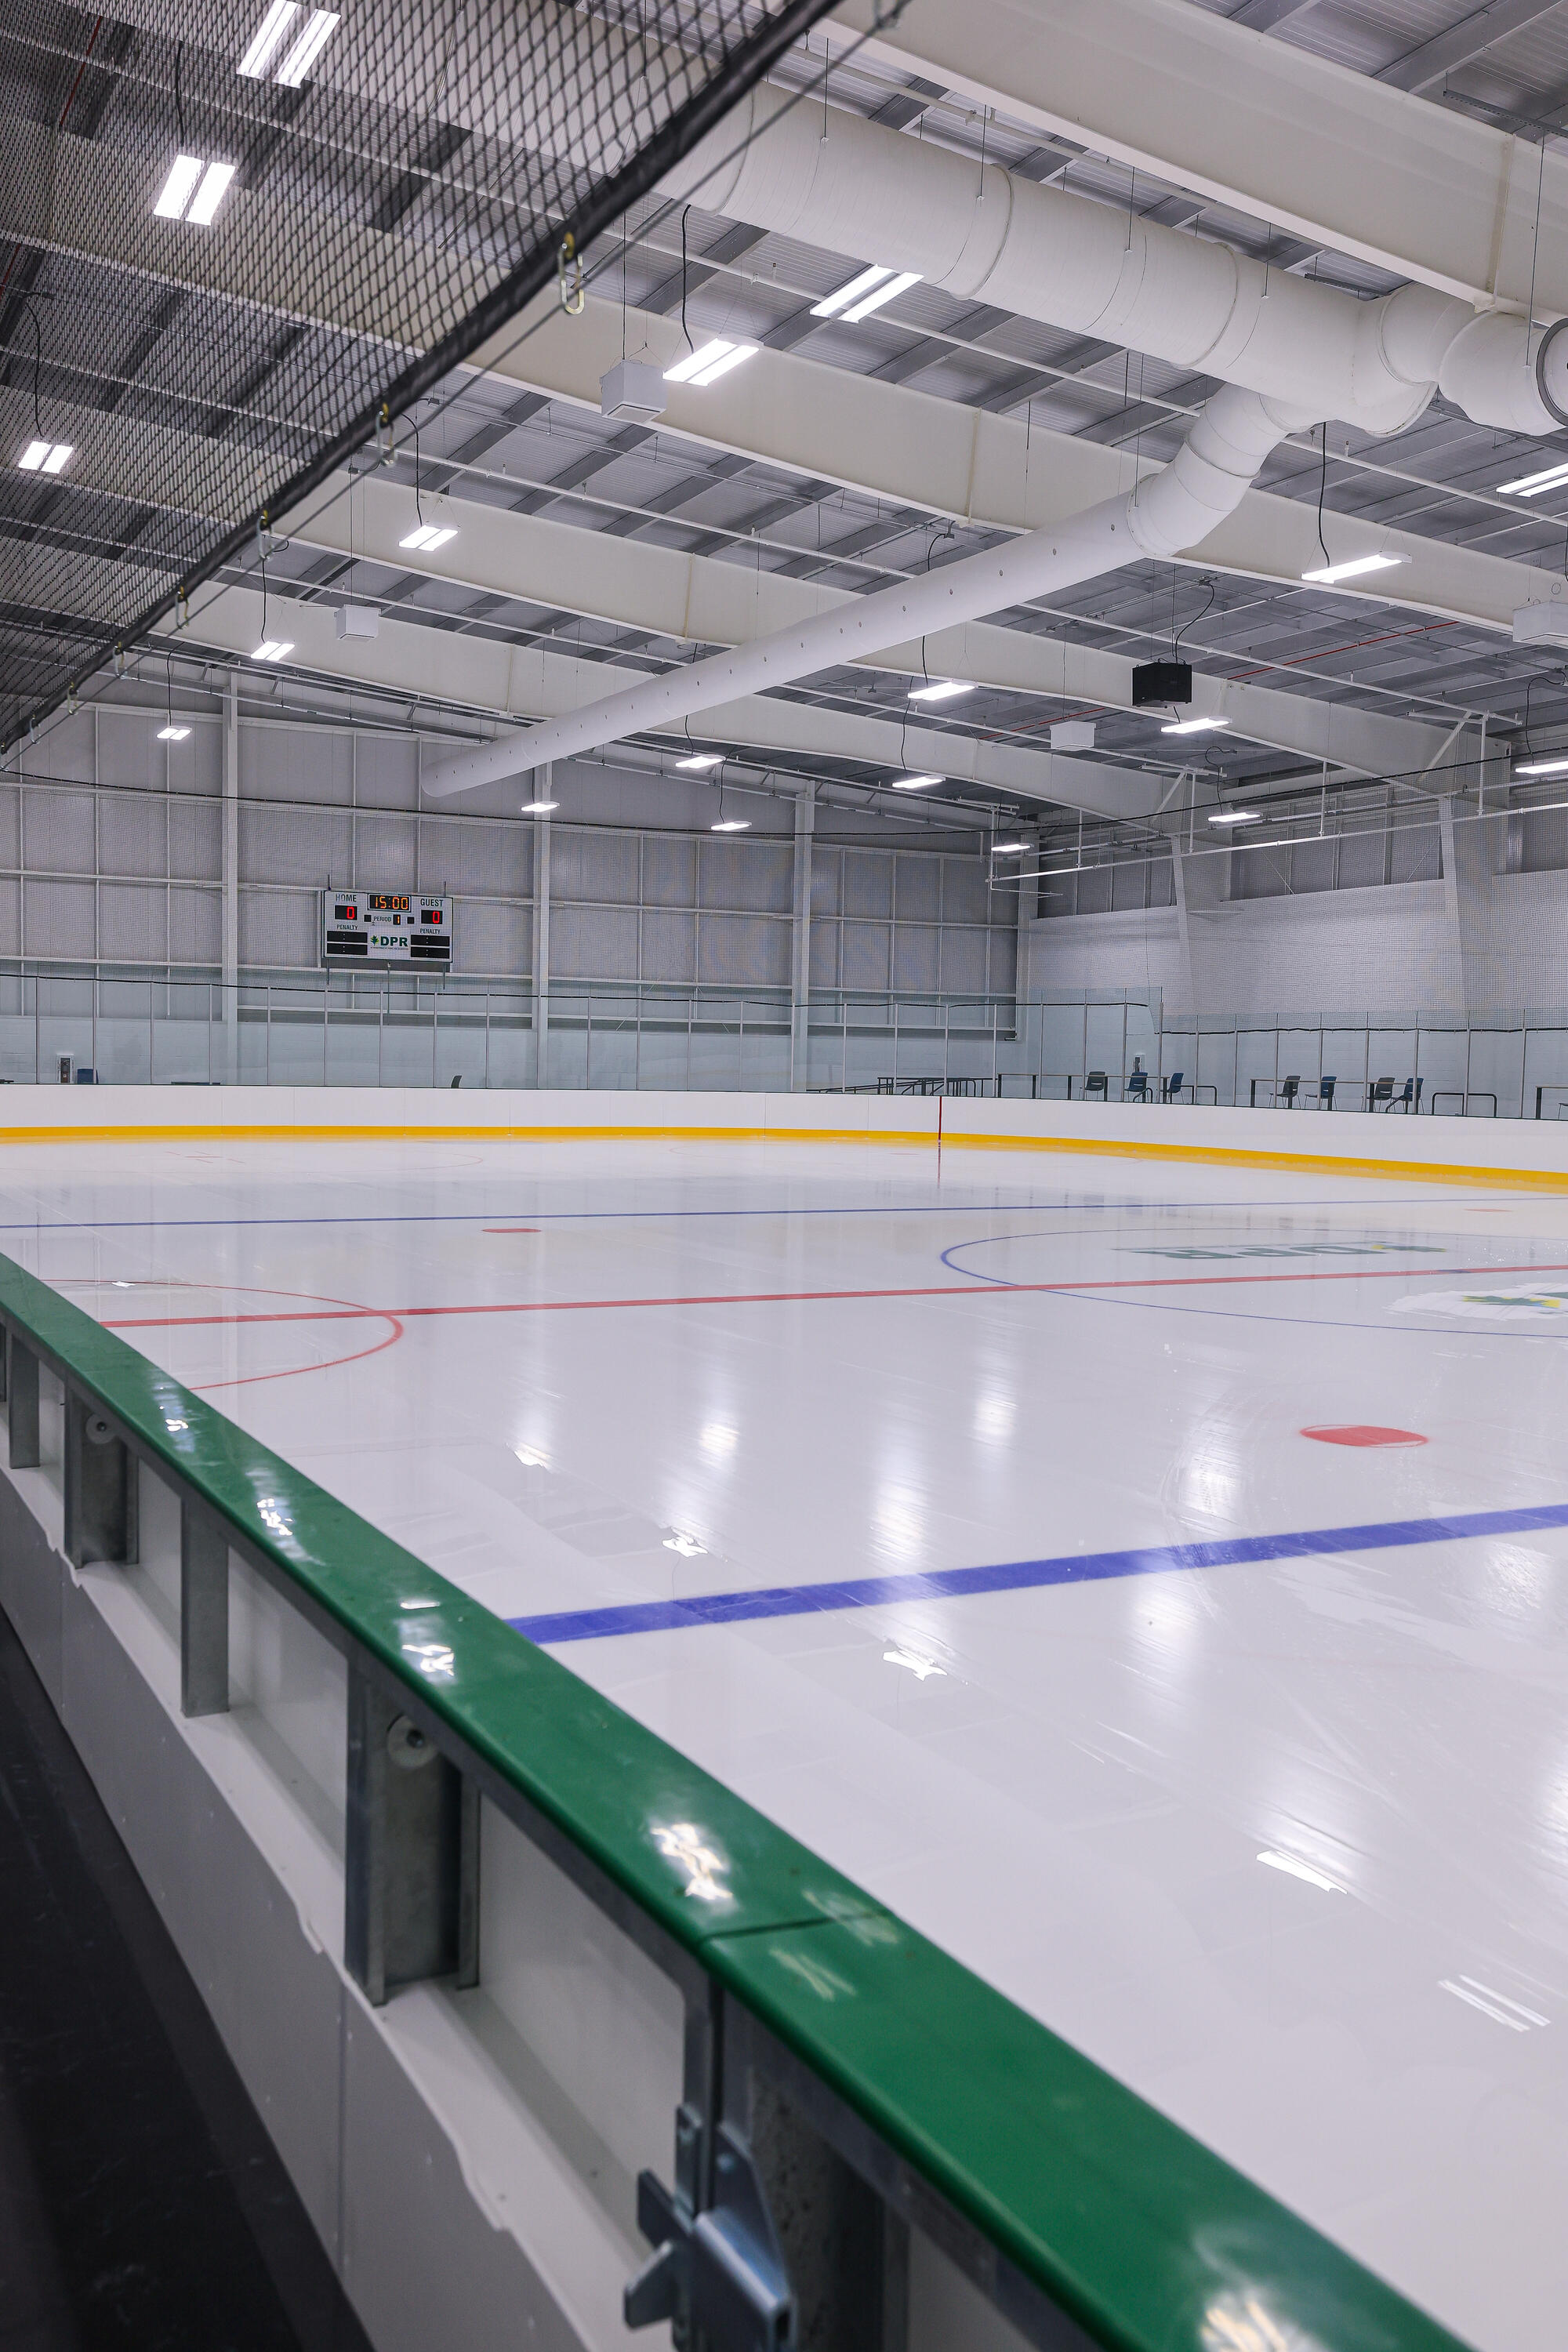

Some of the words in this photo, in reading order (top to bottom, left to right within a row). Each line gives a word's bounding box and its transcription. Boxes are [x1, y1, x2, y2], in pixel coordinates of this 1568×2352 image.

[336, 893, 357, 902] HOME
[375, 896, 408, 909] 15:00
[420, 898, 444, 907] GUEST
[347, 906, 355, 920] 0
[432, 911, 440, 924] 0
[380, 936, 408, 947] DPR
